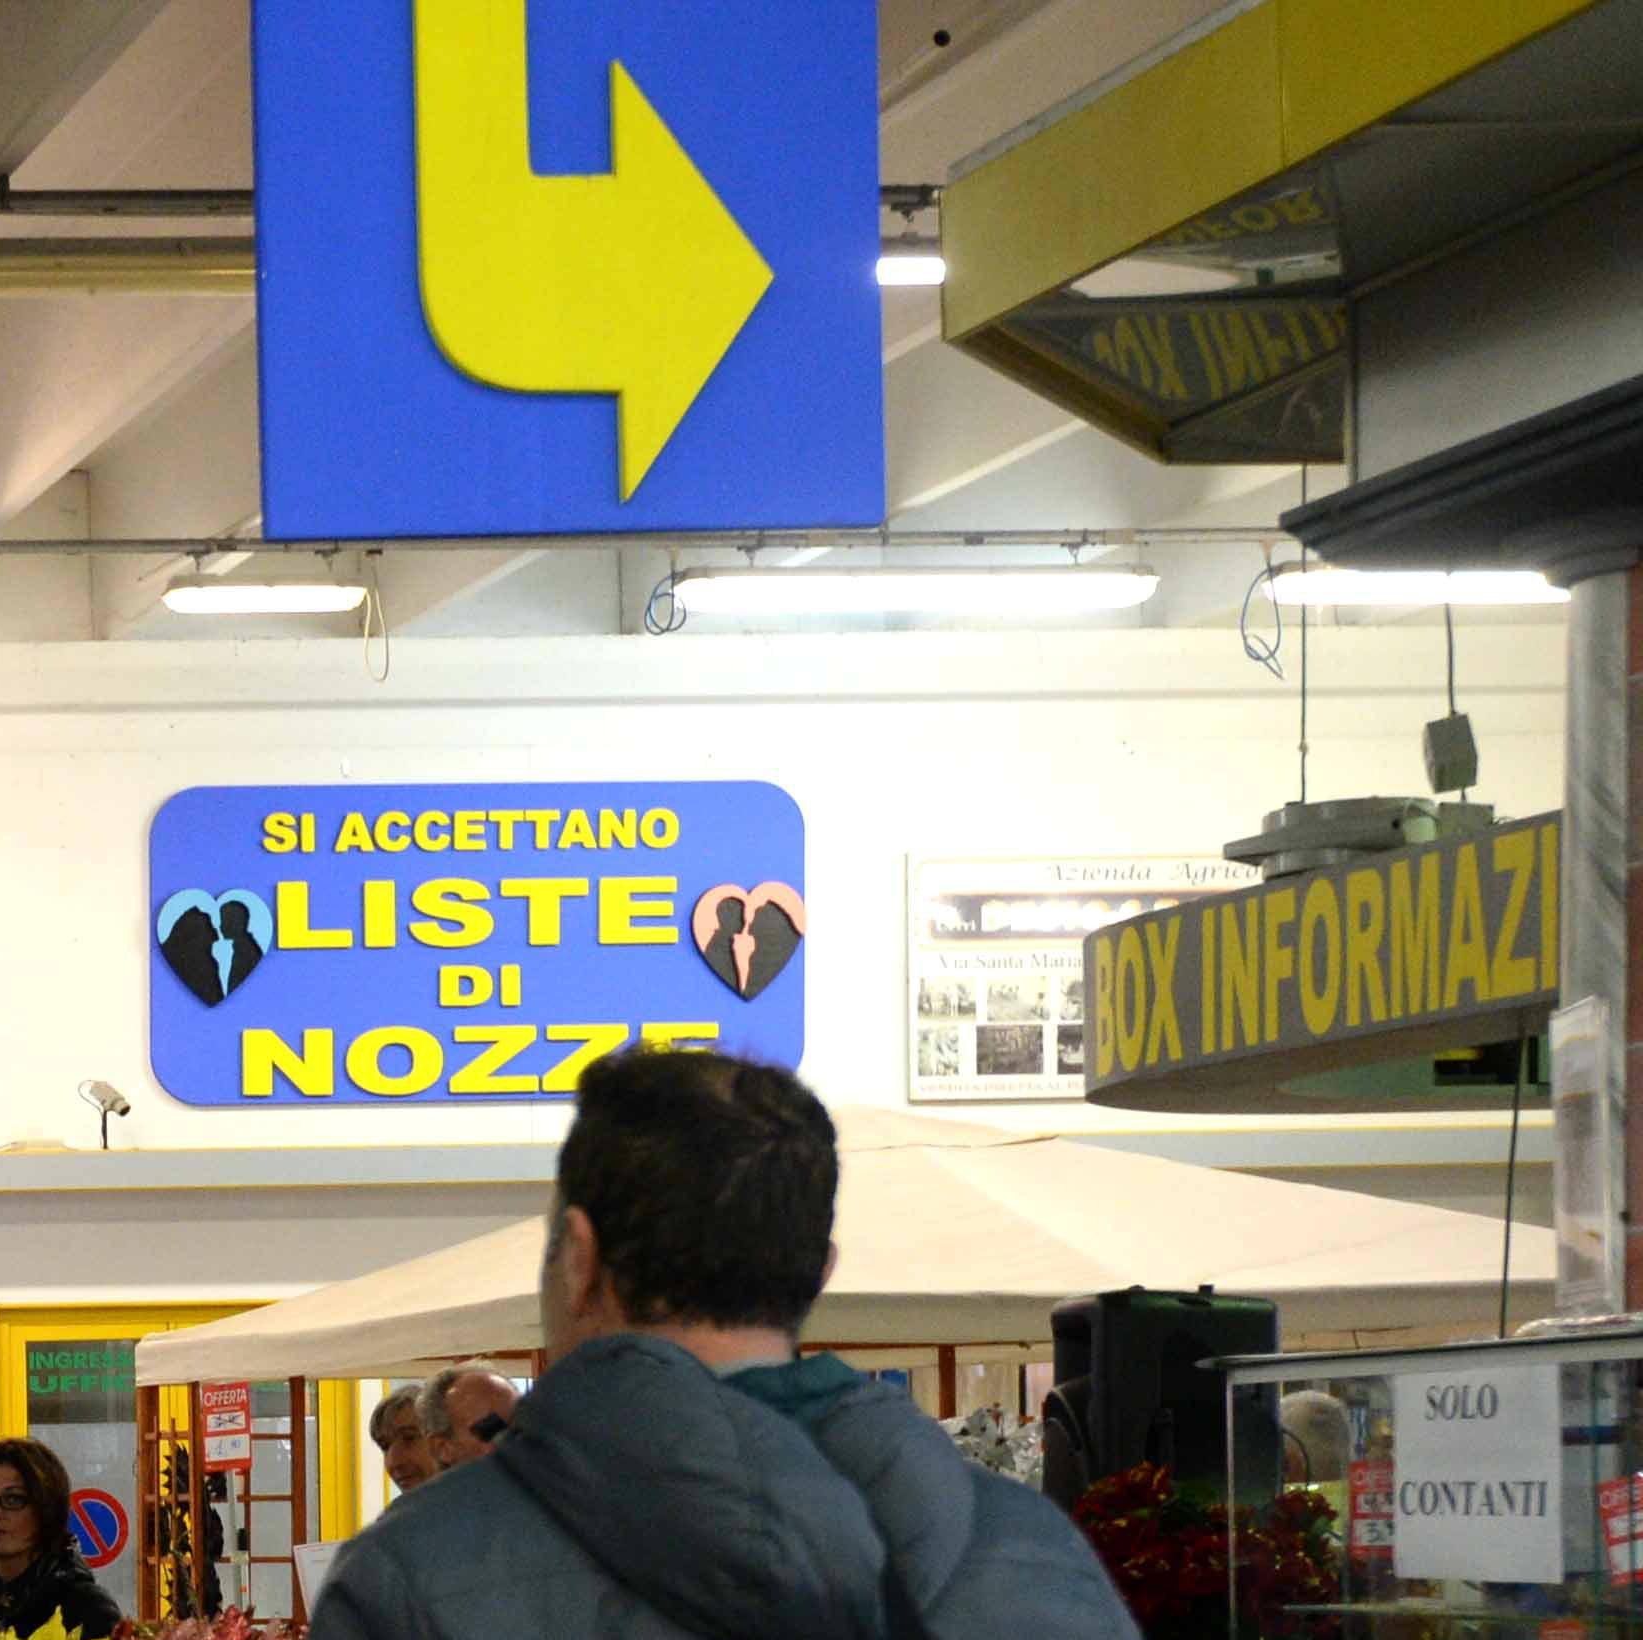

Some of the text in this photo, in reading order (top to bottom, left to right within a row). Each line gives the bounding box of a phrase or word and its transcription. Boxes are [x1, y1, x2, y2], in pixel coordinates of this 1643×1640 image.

[261, 807, 681, 854] SI ACCETTANO
[1047, 863, 1153, 883] Azienda
[275, 876, 681, 951] LISTE
[1094, 823, 1559, 1079] BOX INFORMAZI
[437, 964, 522, 1008] DI
[203, 1388, 248, 1408] OFFERTA
[1425, 1383, 1499, 1421] SOLO
[1398, 1479, 1549, 1518] CONTANTI
